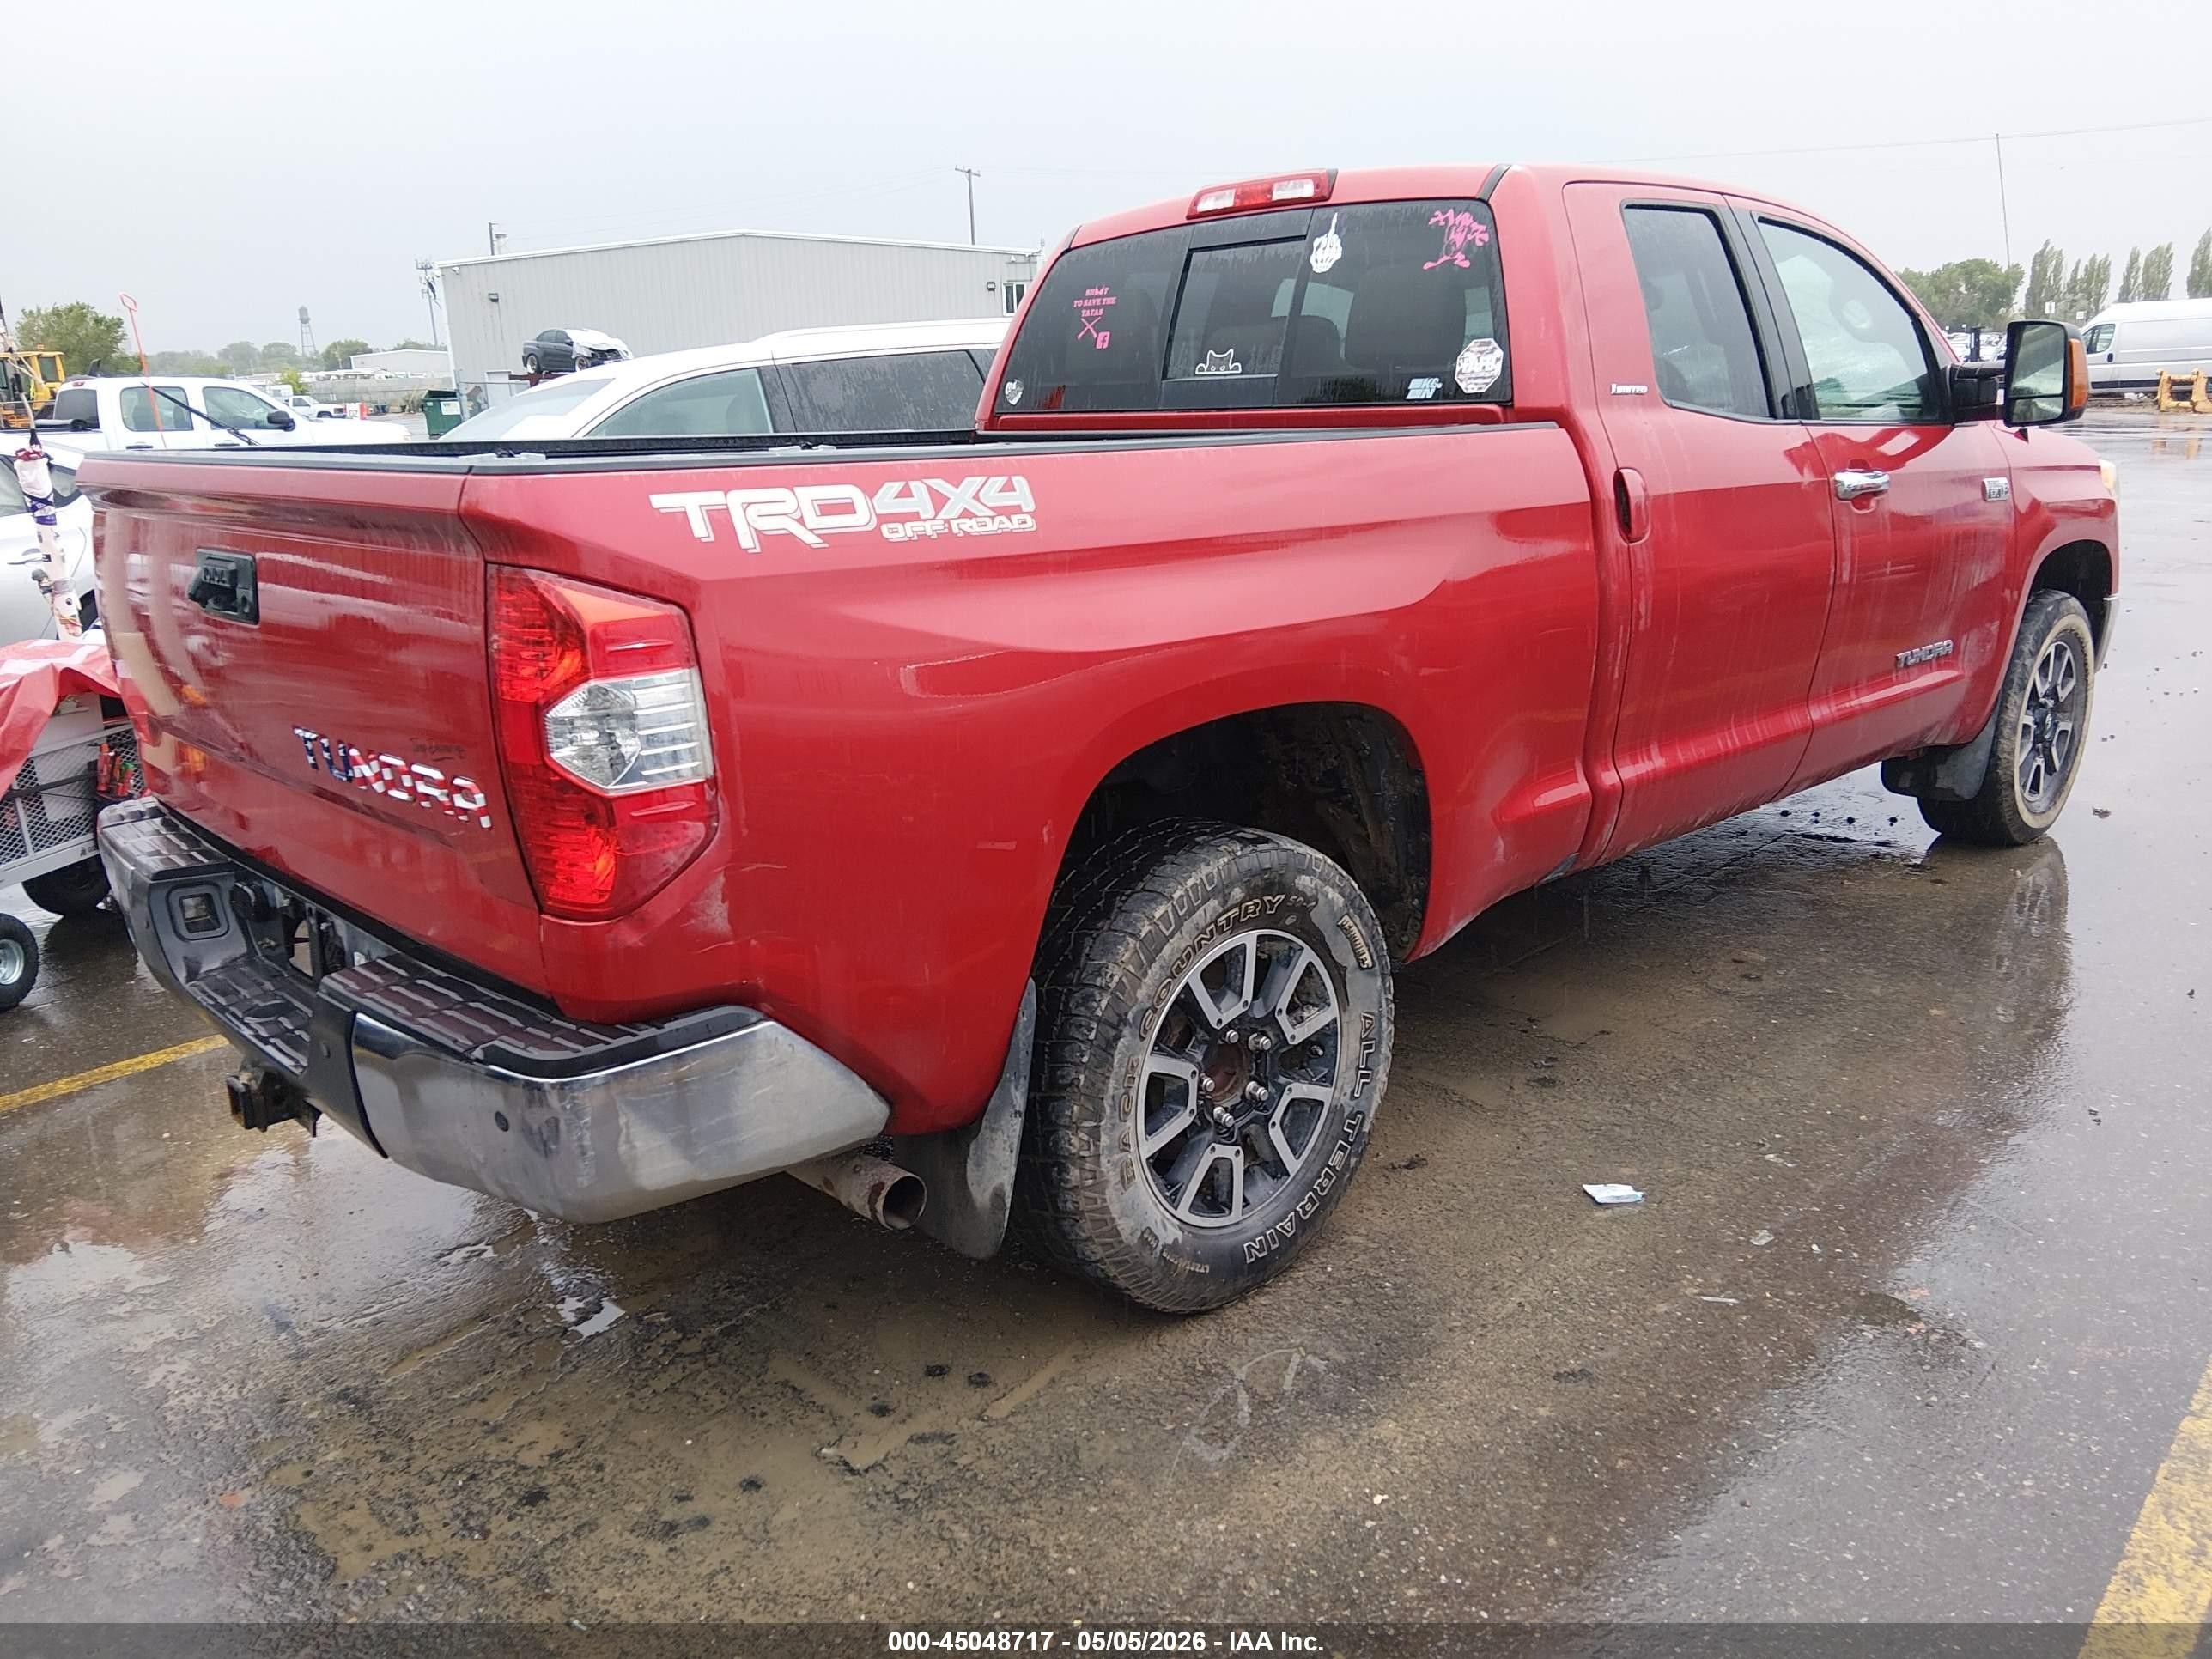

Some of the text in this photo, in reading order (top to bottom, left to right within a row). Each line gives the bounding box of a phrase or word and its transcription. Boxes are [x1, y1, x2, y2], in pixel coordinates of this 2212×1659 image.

[1081, 308, 1104, 317] TATAS
[1083, 298, 1101, 307] SAVE
[648, 483, 878, 554] TRD
[1895, 639, 1954, 668] TUNDRA
[292, 725, 493, 830] TUNDRA
[1139, 894, 1286, 1042] COUNTRY
[1352, 1012, 1377, 1100] ALL
[1243, 1113, 1366, 1264] TERRAIN
